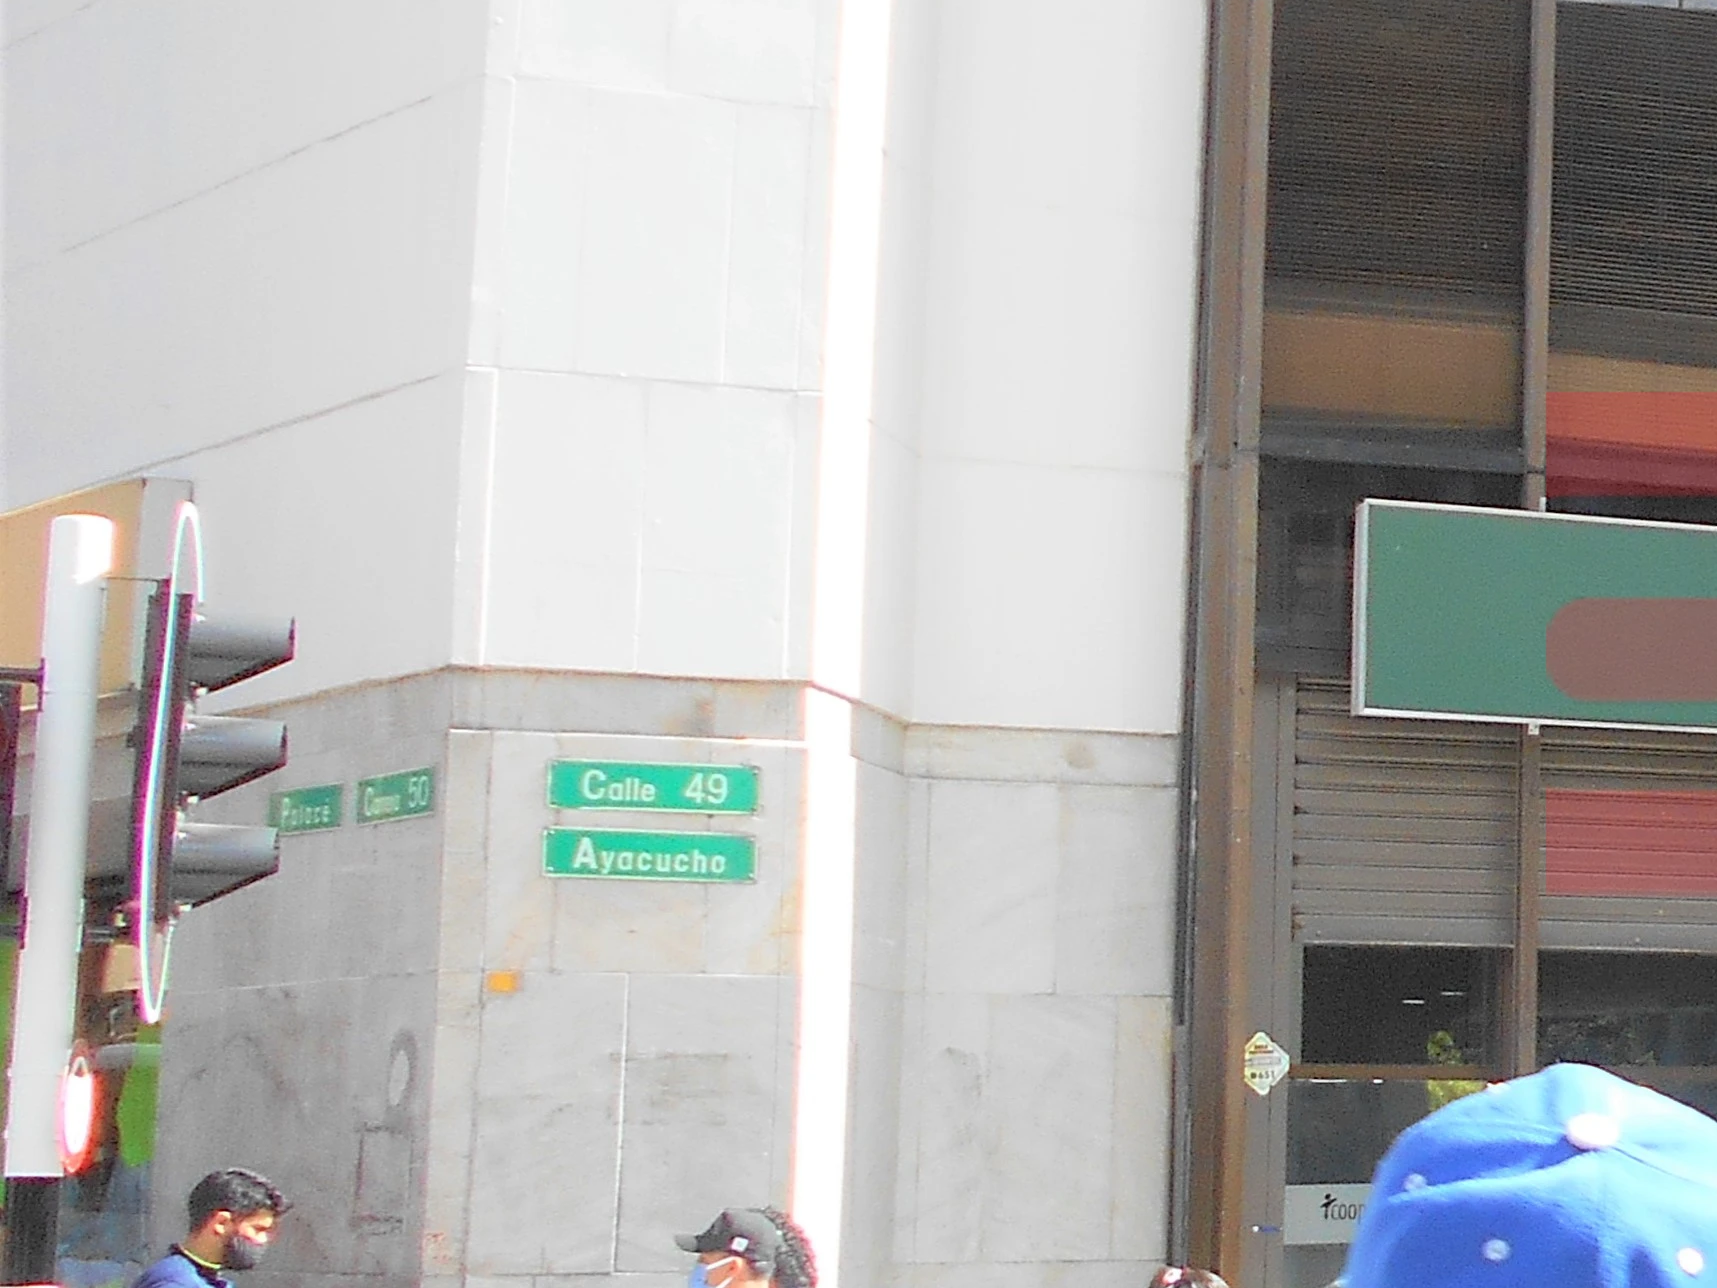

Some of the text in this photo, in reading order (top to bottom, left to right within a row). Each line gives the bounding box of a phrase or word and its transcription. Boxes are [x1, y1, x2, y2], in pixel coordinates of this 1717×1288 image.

[407, 774, 430, 809] 50
[582, 768, 729, 805] Calle 49
[572, 836, 727, 875] Ayacucho
